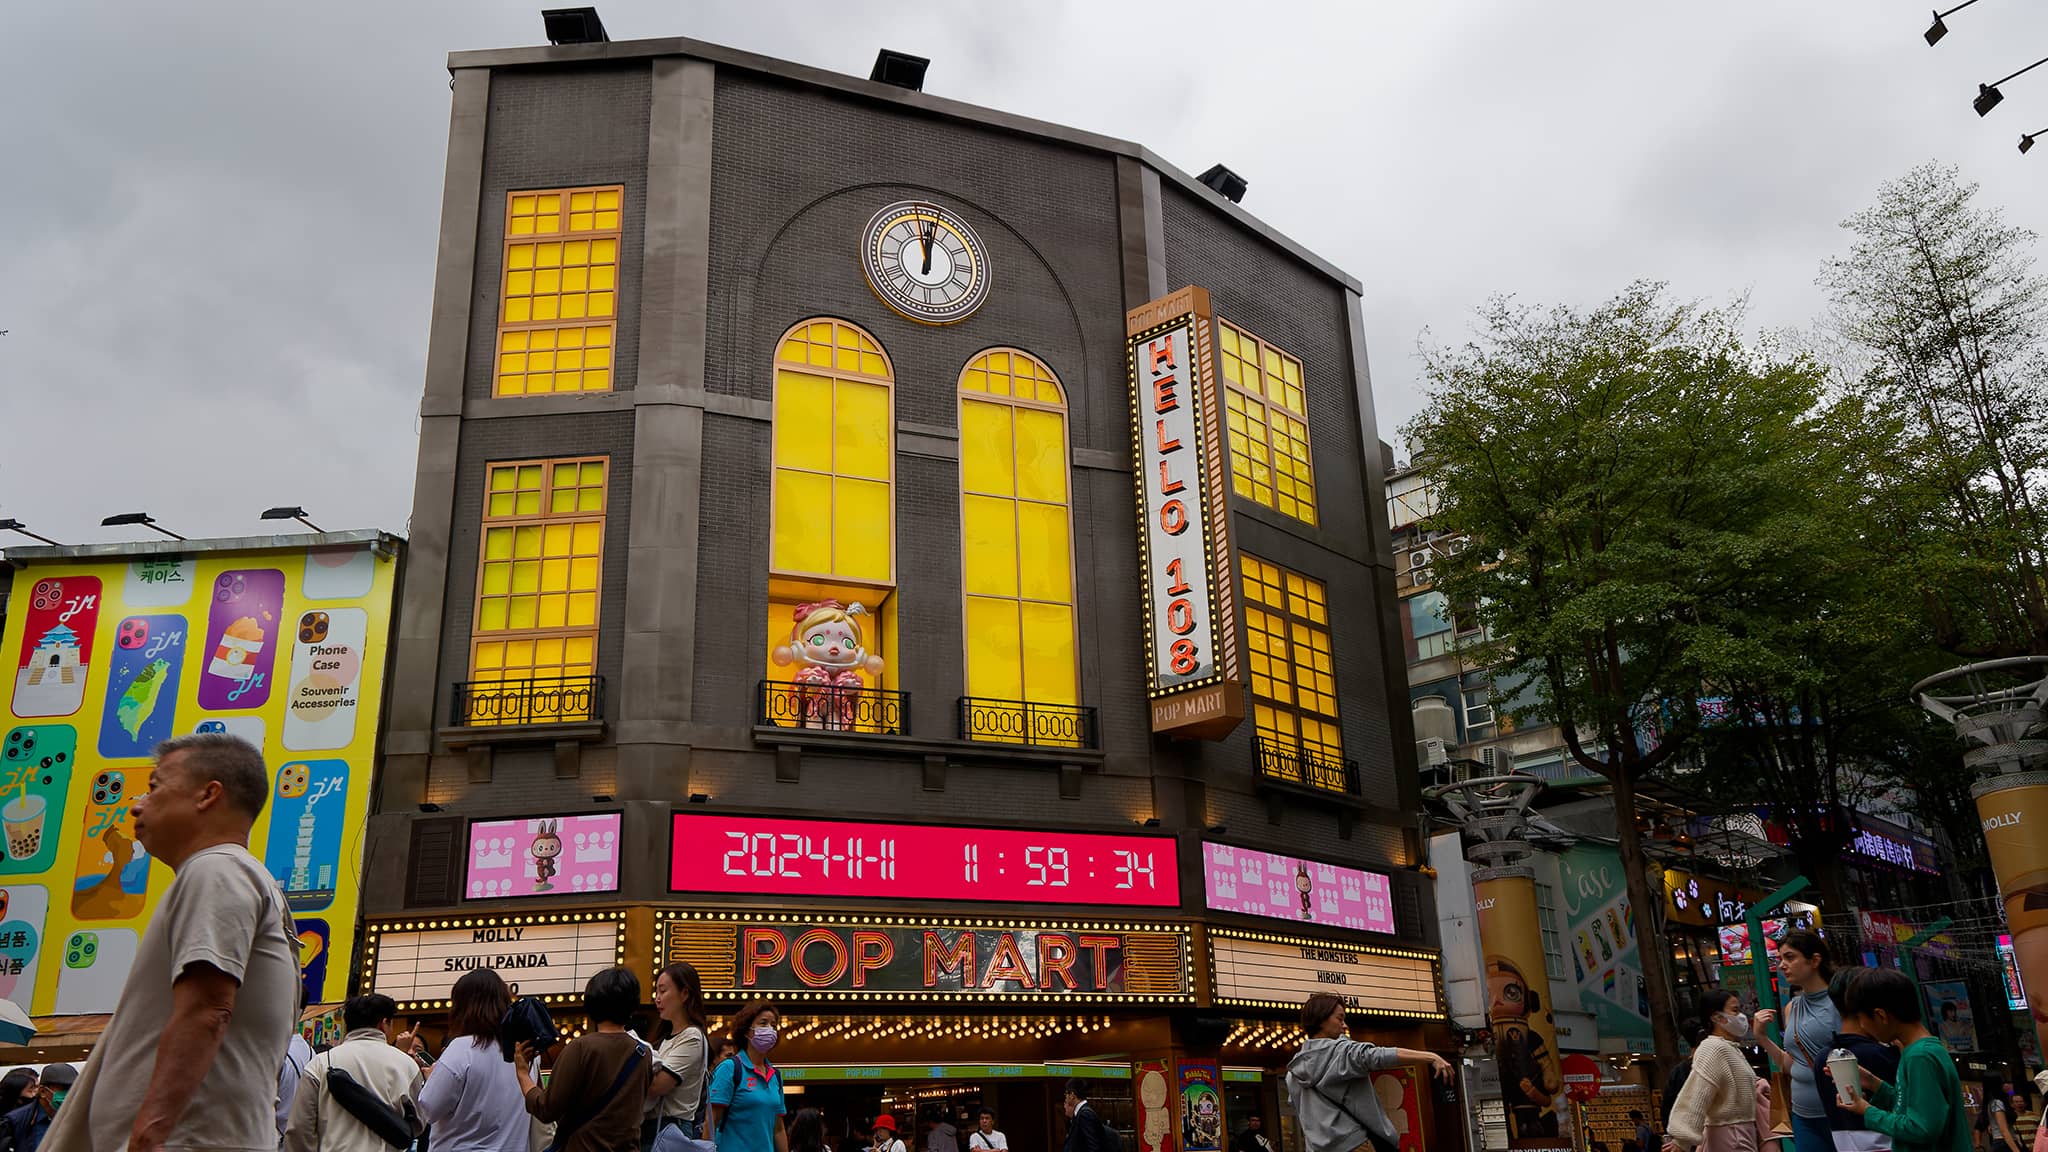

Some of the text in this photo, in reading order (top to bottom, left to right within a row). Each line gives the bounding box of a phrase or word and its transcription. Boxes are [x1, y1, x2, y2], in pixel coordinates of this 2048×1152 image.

[1147, 335, 1201, 678] HELLO 108
[310, 645, 348, 656] Phone
[313, 660, 341, 671] Case
[301, 685, 350, 697] Souvenir
[291, 697, 357, 710] Accessories
[1155, 690, 1223, 725] POP MART
[723, 831, 896, 882] 2024-11-11
[1559, 861, 1615, 917] Case
[472, 927, 524, 943] MOLLY
[444, 953, 549, 972] SKULLPANDA
[741, 927, 1121, 990] POP MART
[1300, 947, 1359, 965] THE MONSTERS
[1316, 970, 1348, 985] HIRONO
